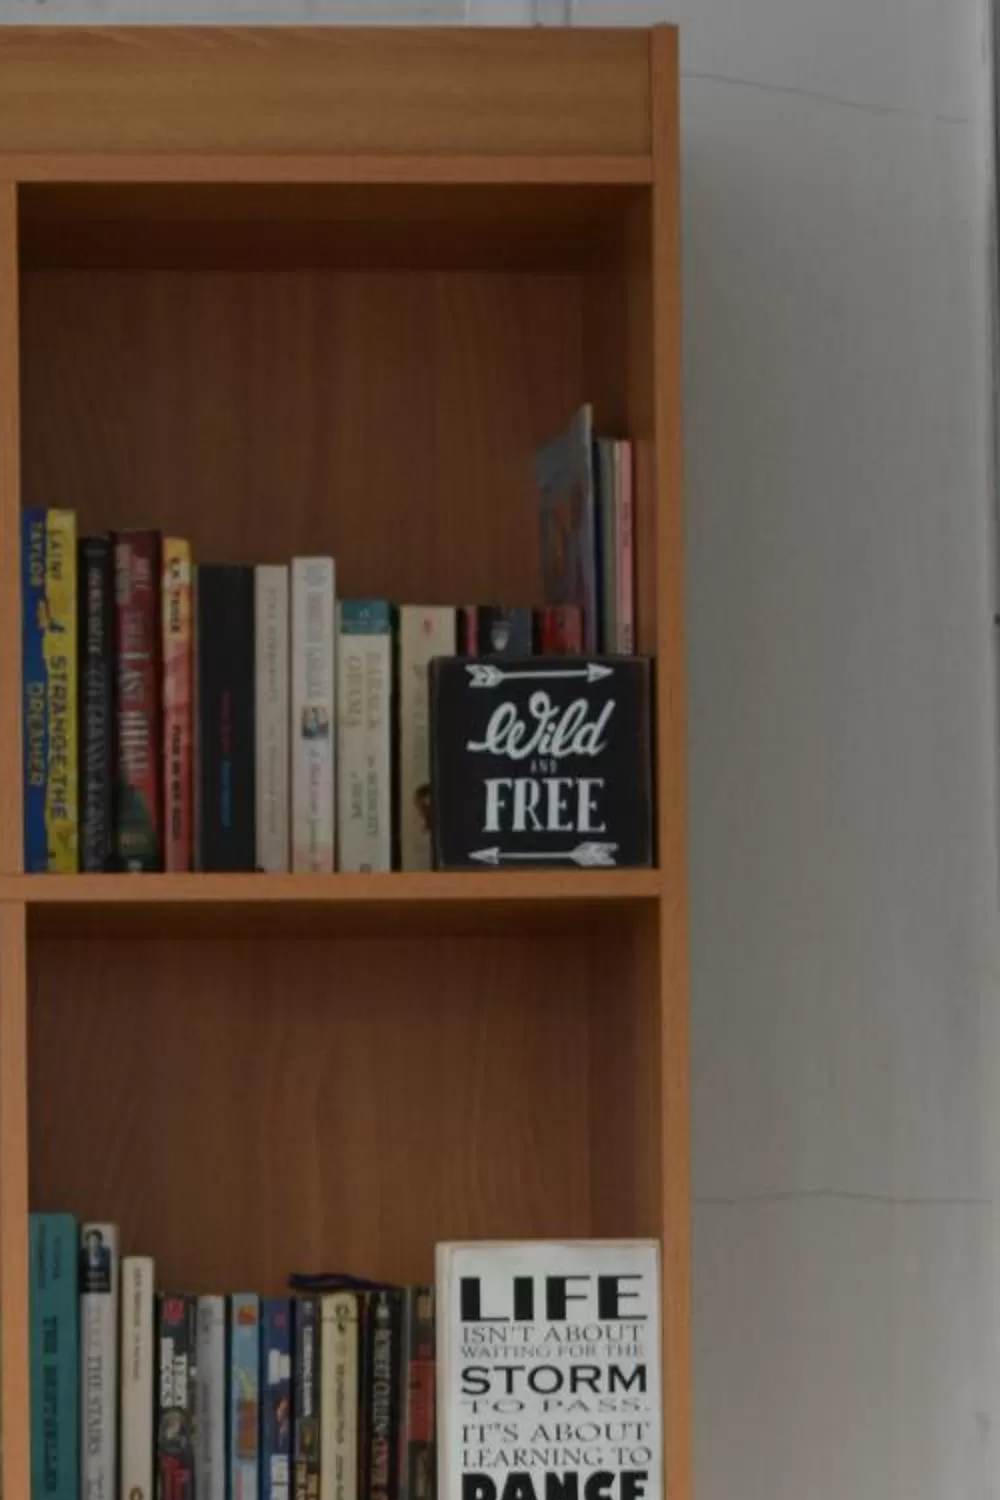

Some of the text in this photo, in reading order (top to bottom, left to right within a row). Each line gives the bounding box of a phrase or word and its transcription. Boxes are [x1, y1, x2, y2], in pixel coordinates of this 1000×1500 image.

[466, 690, 617, 760] Wild
[482, 776, 606, 833] FREE
[461, 1275, 648, 1321] LIFE
[462, 1324, 645, 1344] ISN'T ABOUT
[462, 1344, 551, 1359] WAITING
[558, 1344, 596, 1358] FOR
[461, 1365, 647, 1396] STORM
[461, 1398, 526, 1415] TO
[462, 1422, 650, 1444] IT'S ABOUT
[462, 1446, 652, 1468] LEARNING TO
